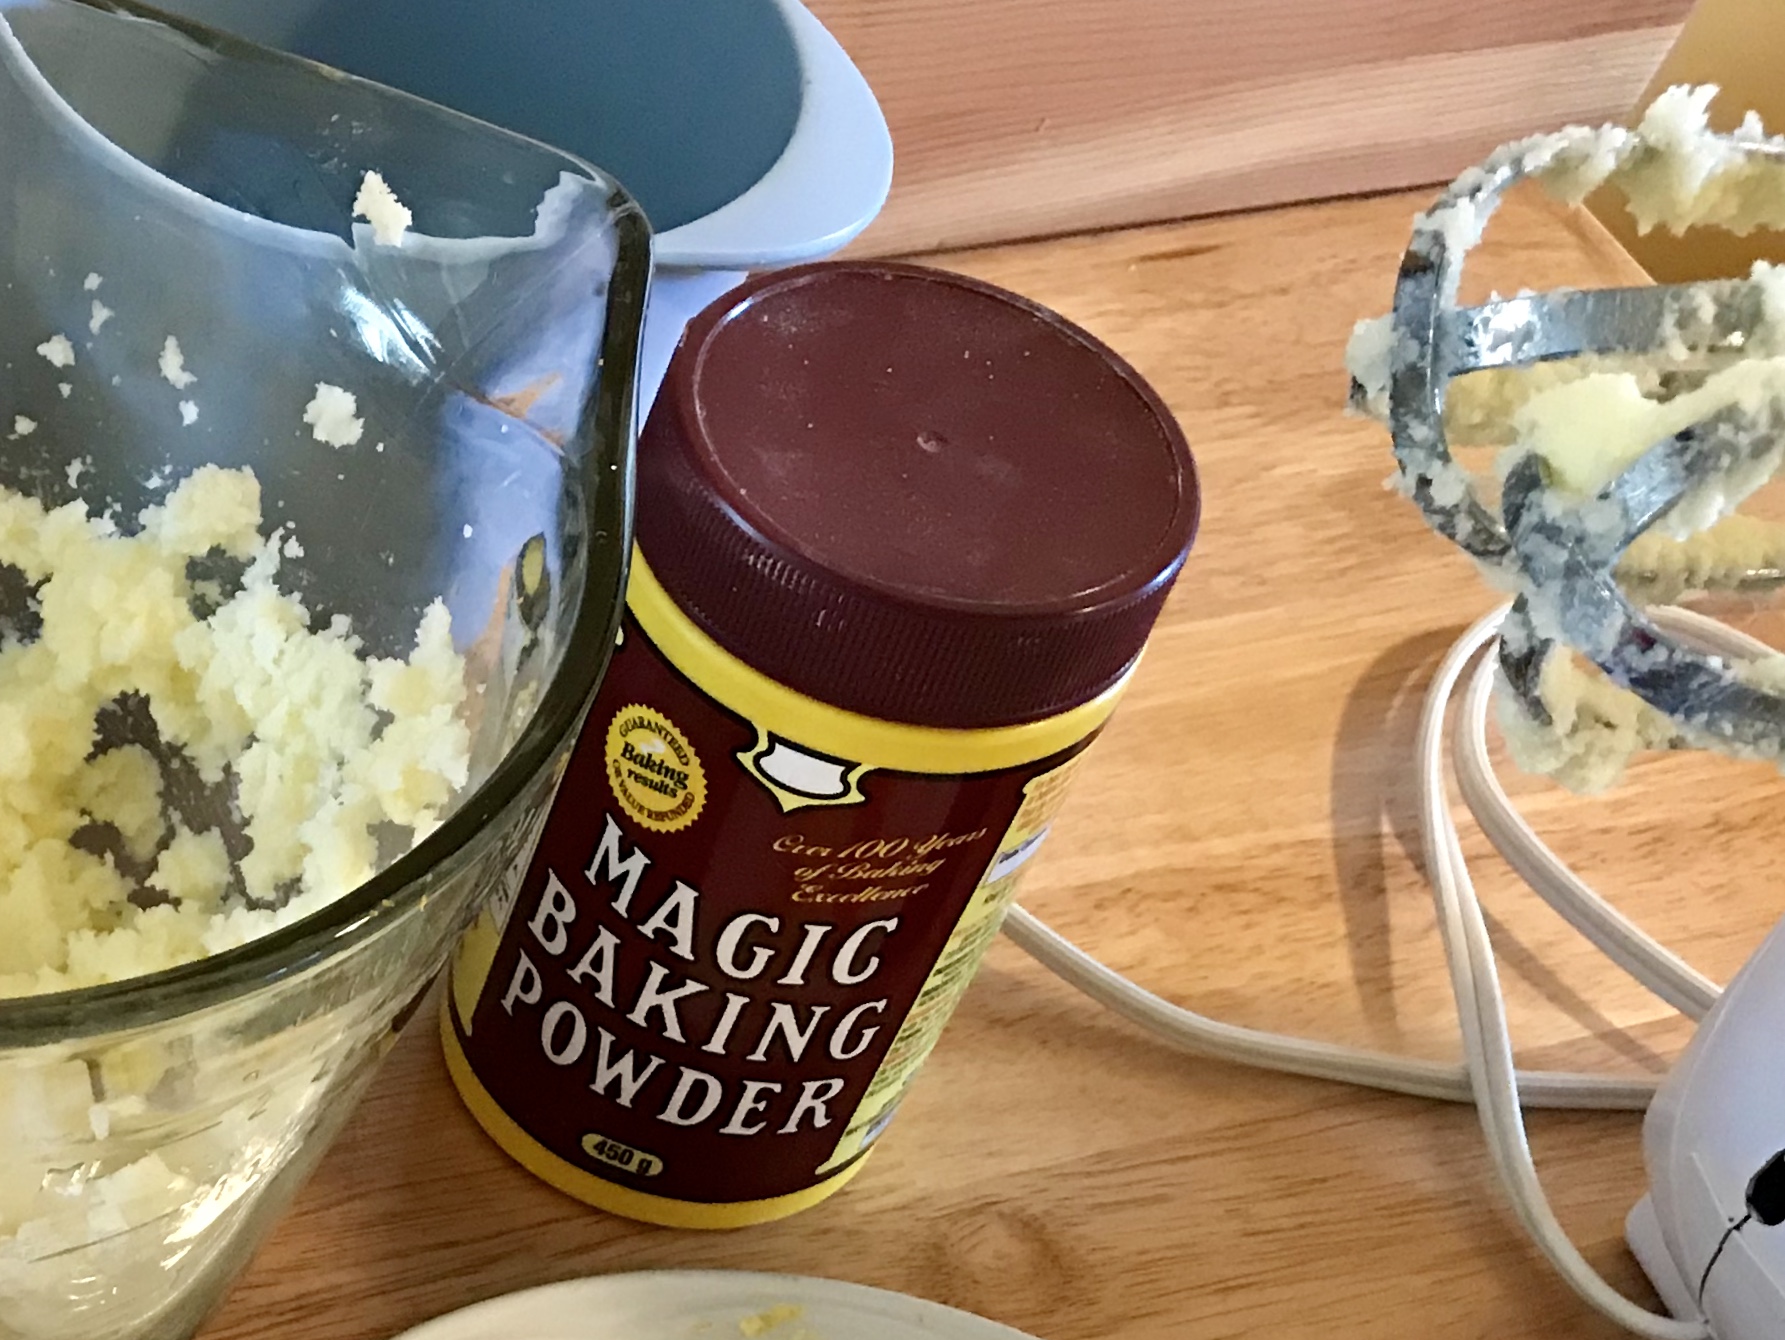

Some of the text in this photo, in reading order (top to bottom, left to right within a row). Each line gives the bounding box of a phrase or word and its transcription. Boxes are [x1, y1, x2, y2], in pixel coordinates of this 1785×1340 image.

[619, 716, 690, 766] GUARANTEED
[621, 741, 690, 790] Baking
[627, 768, 678, 798] results
[619, 779, 645, 815] VALUE
[646, 792, 695, 822] REFUNDED
[772, 834, 832, 857] Over
[837, 838, 909, 858] 100
[907, 827, 988, 860] Years
[793, 857, 947, 882] of Baking
[584, 813, 898, 986] MAGIC
[791, 883, 930, 903] Excellence
[527, 868, 887, 1063] BAKING
[500, 949, 845, 1136] POWDER
[593, 1139, 653, 1175] 450 g
